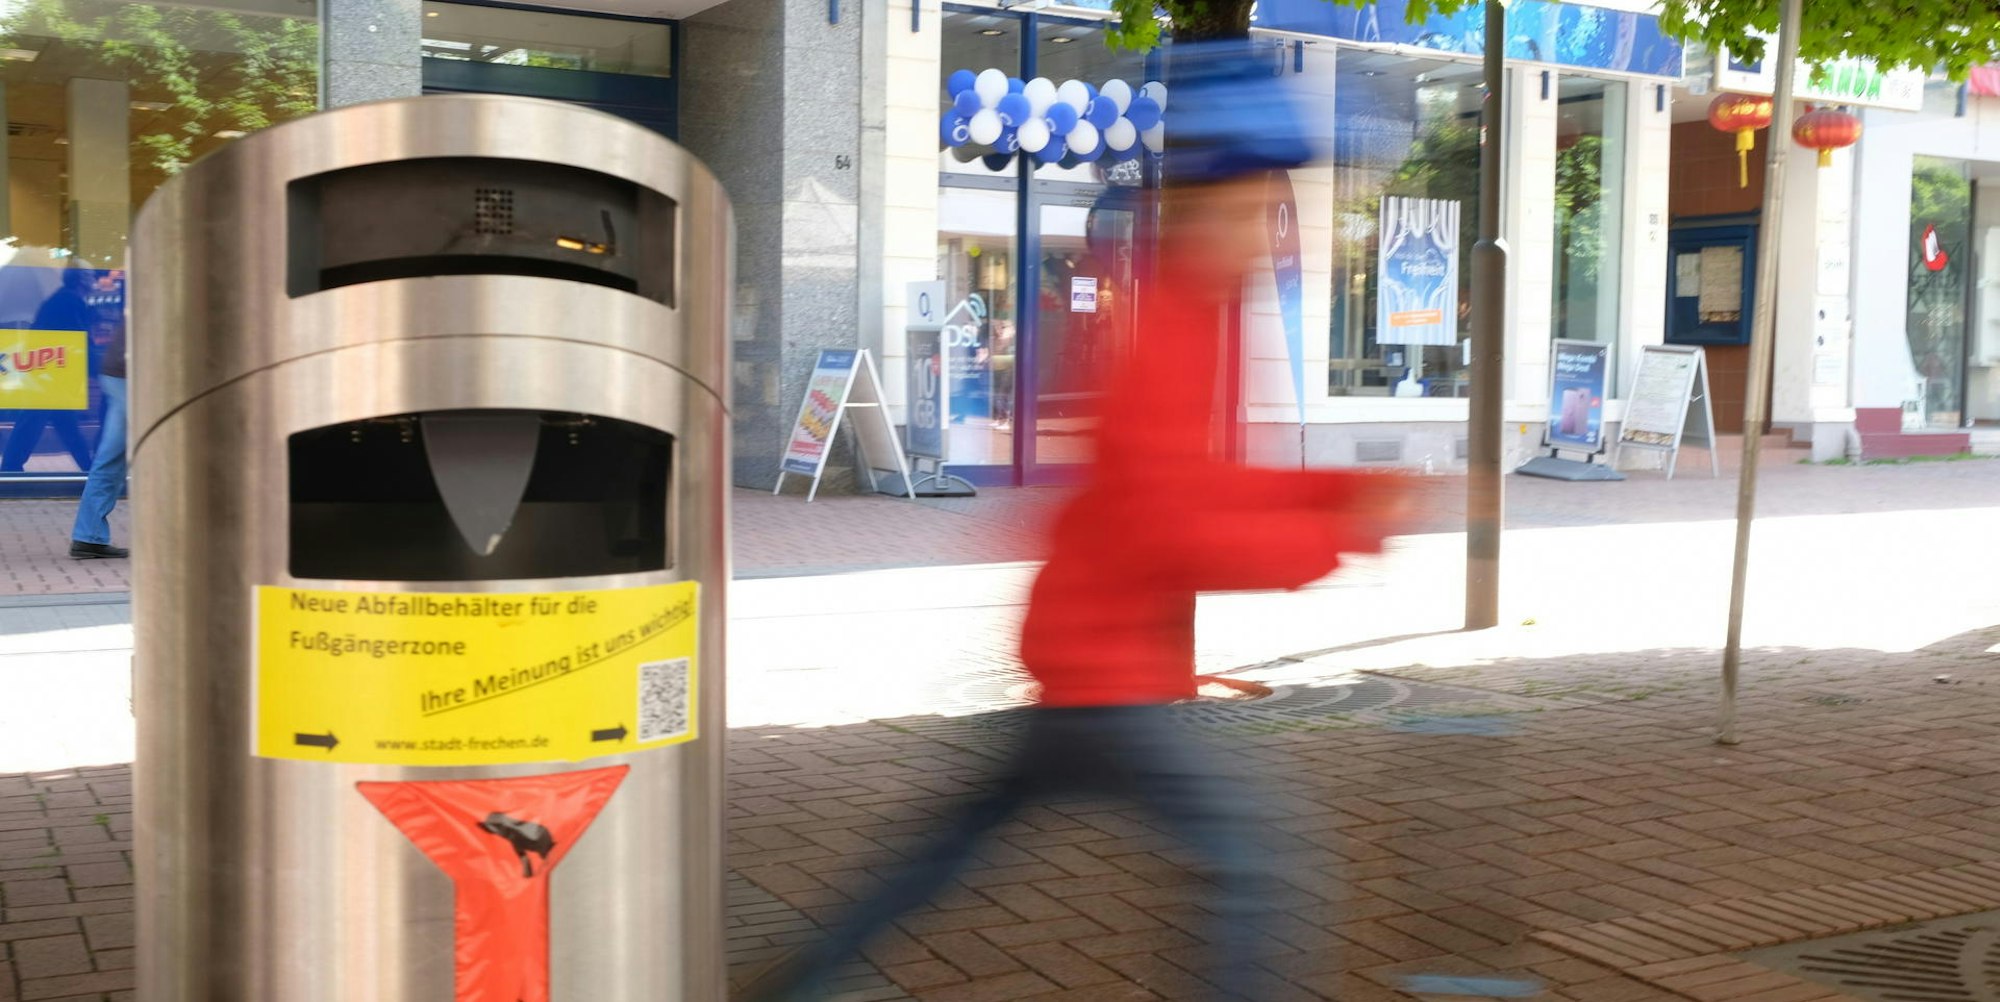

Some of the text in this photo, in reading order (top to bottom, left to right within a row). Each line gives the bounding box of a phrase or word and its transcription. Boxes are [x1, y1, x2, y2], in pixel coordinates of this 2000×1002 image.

[835, 154, 851, 170] 64
[12, 347, 66, 372] UP!
[290, 592, 598, 617] Neue Abfallbehälter für die
[290, 630, 466, 659] Fußgängerzone
[420, 689, 466, 713] Ihre
[473, 655, 571, 699] Meinung
[576, 642, 601, 664] ist
[605, 630, 635, 653] uns
[375, 735, 550, 750] www.stadt-frechen.de
